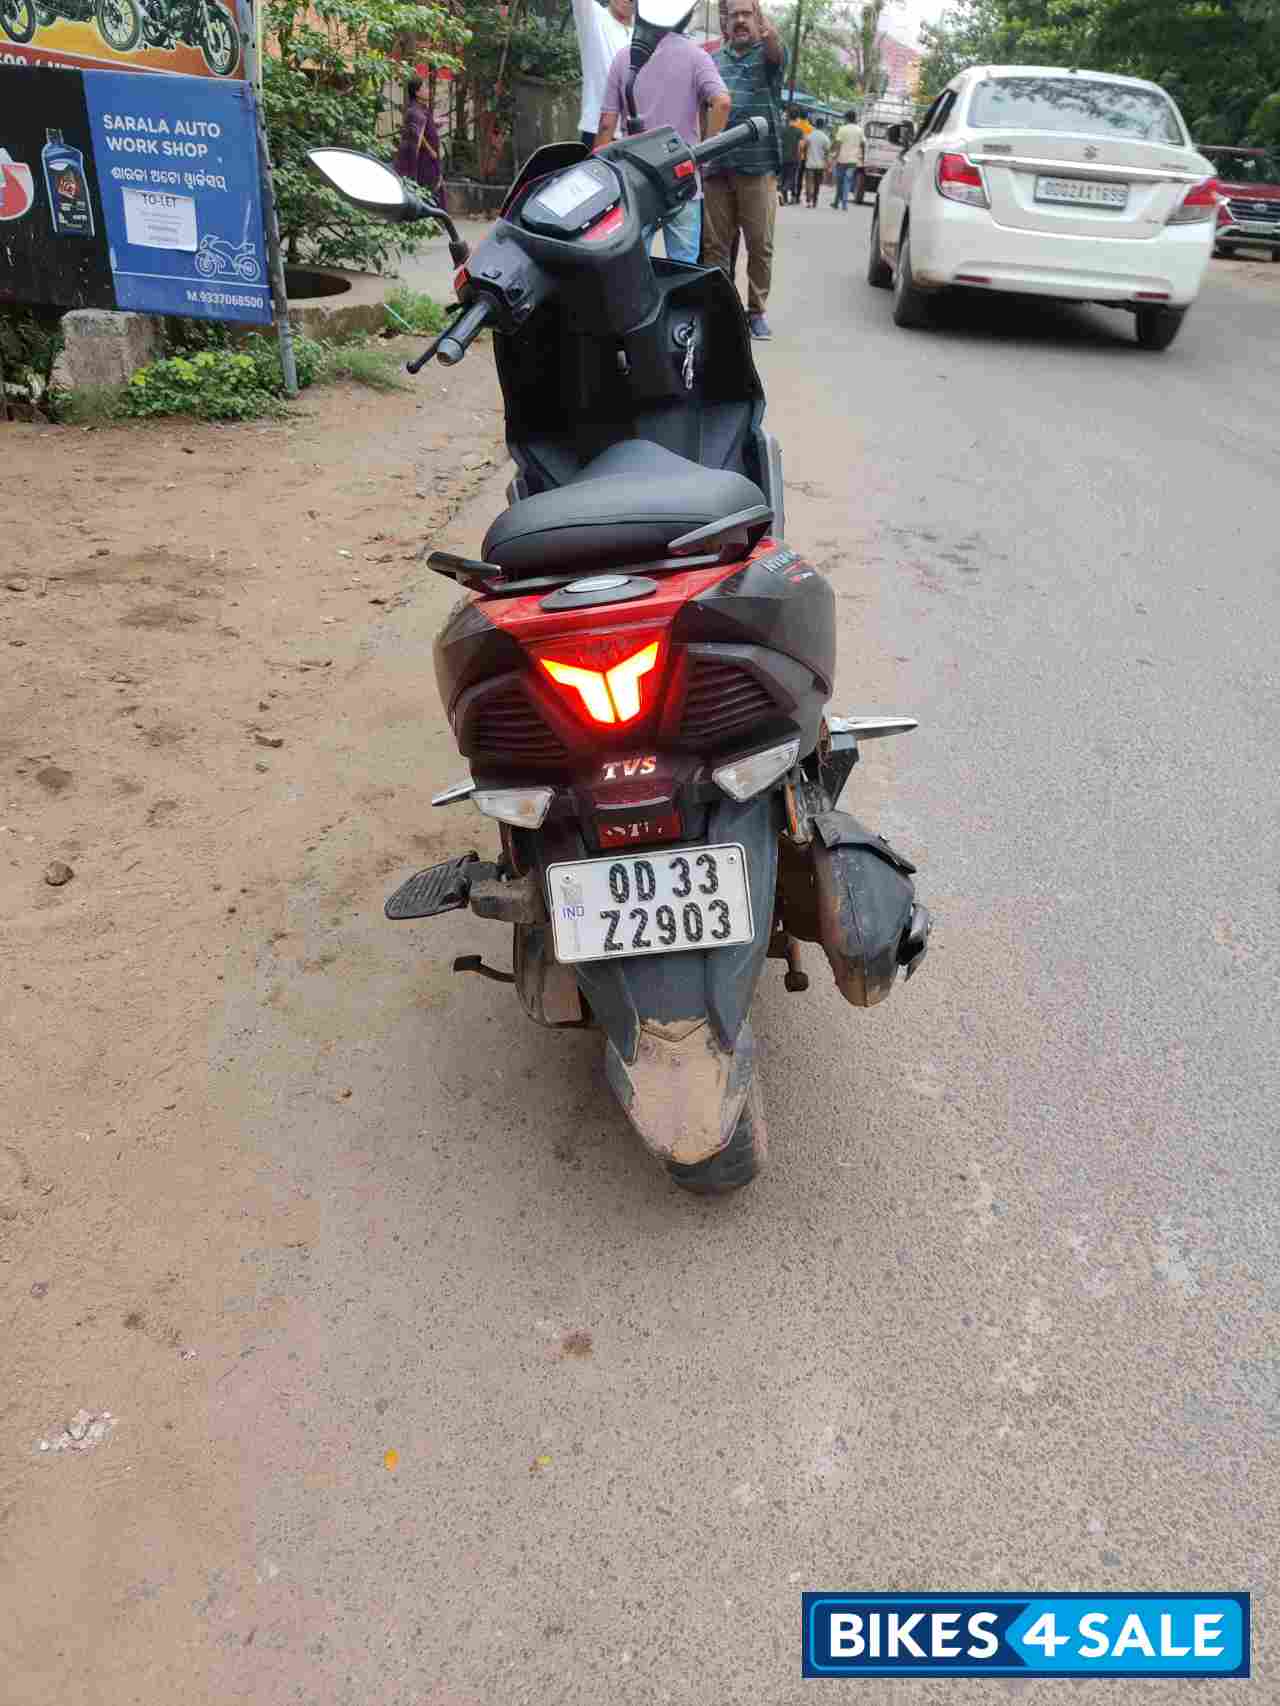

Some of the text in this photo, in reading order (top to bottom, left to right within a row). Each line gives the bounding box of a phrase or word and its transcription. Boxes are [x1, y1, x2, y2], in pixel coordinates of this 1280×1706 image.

[103, 113, 221, 138] SARALA AUTO
[105, 135, 208, 158] WORK SHOP
[142, 193, 176, 208] TO-LET
[602, 755, 657, 780] TVS
[669, 853, 719, 898] 33
[561, 904, 585, 920] IND
[600, 898, 732, 952] Z2903
